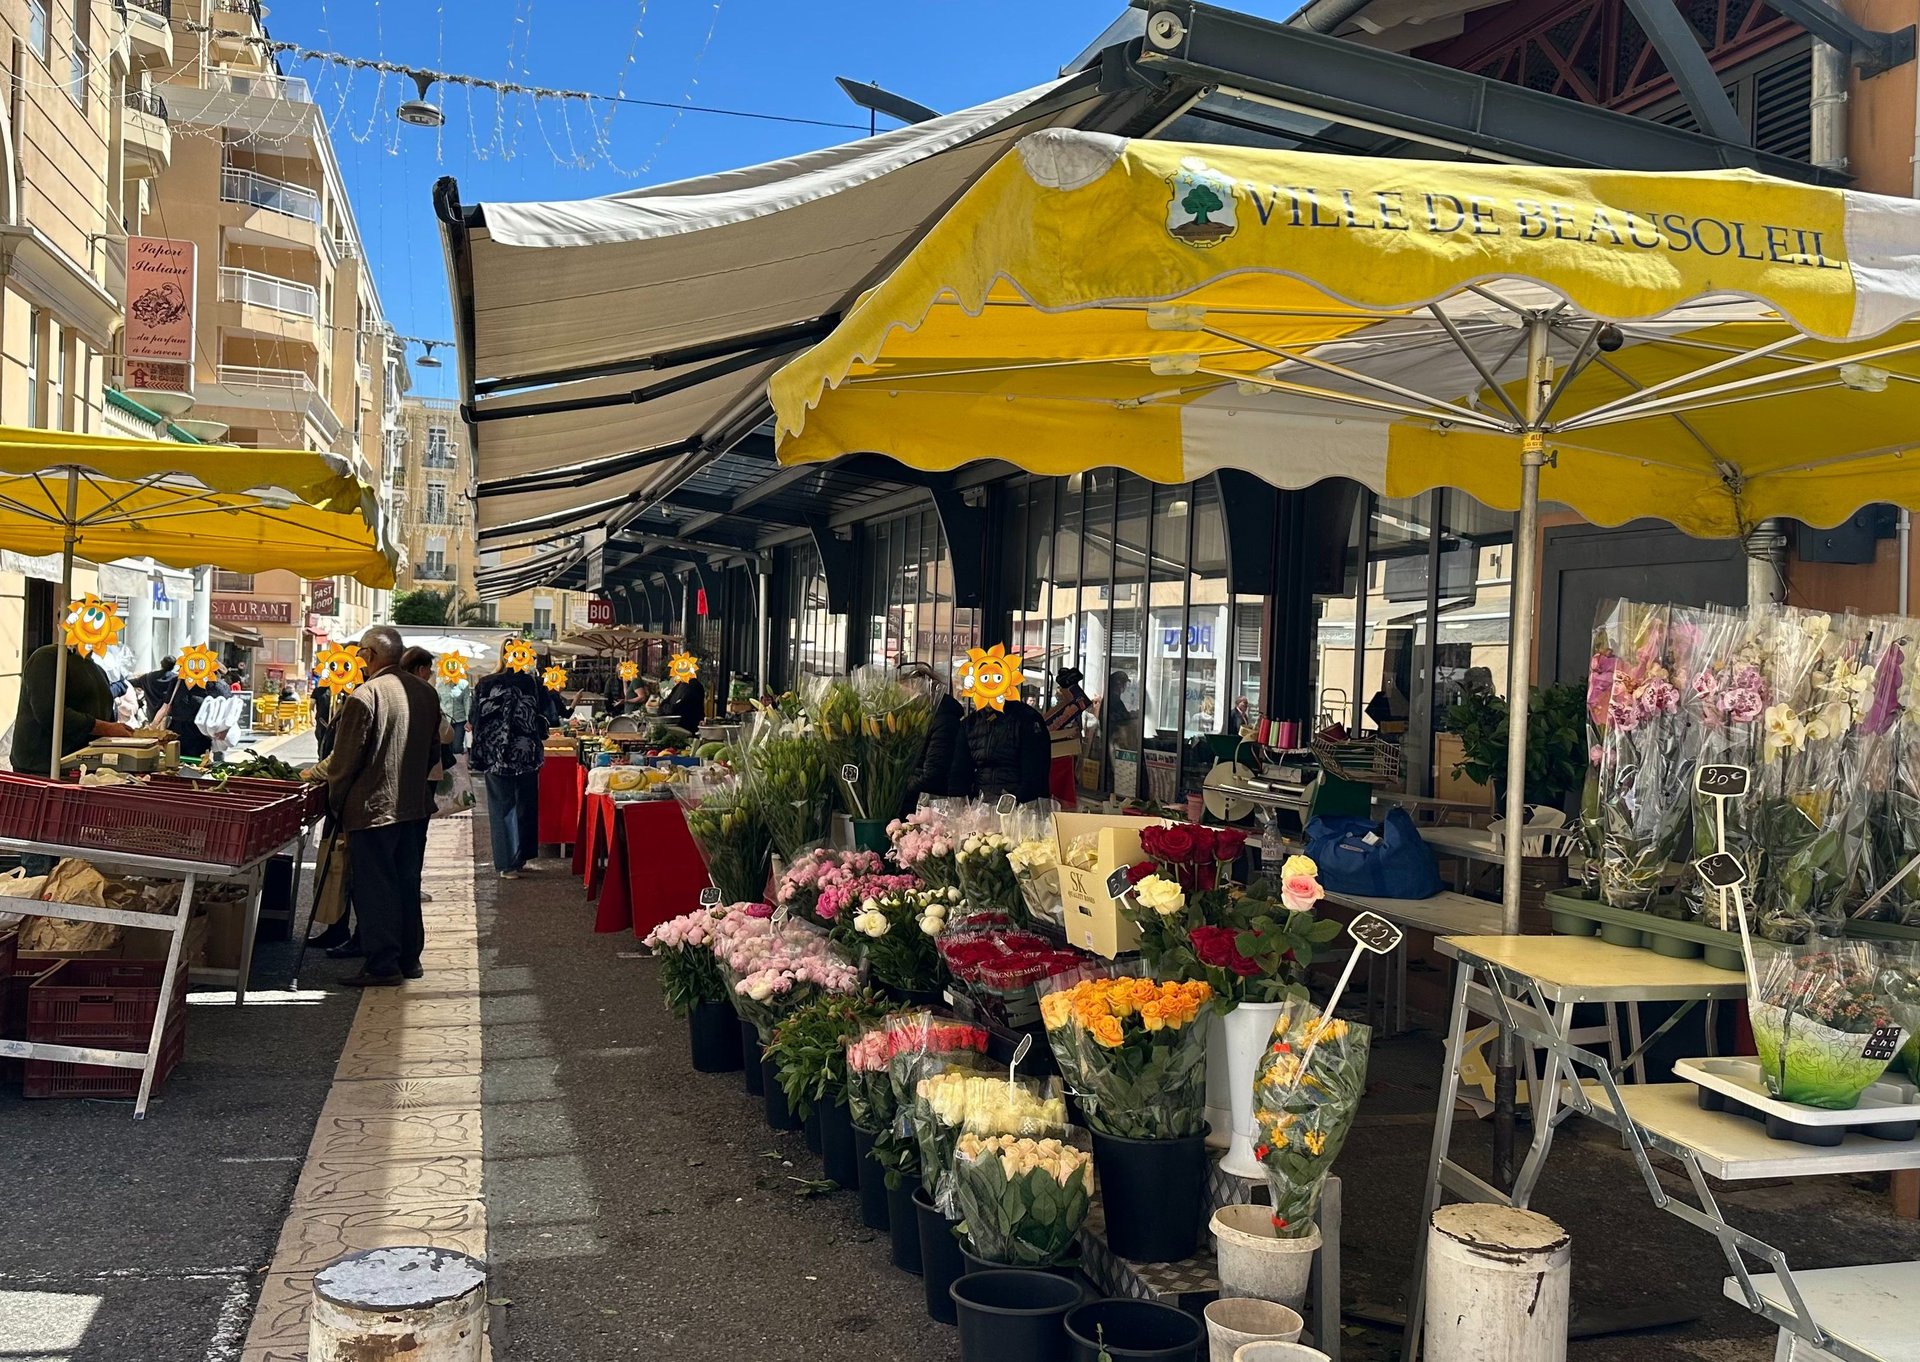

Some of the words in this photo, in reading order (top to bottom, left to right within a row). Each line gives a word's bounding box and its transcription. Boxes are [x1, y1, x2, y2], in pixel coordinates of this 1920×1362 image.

[1245, 184, 1409, 231] VILLE
[1421, 193, 1501, 235] DE
[1515, 199, 1842, 270] BEAUSOLEIL
[138, 242, 183, 258] Sapori
[132, 261, 188, 275] Italiani
[149, 335, 186, 345] parfum
[142, 346, 151, 354] la
[314, 586, 332, 599] FAST
[211, 602, 288, 616] STAURANT
[312, 597, 333, 611] FOOD
[590, 604, 610, 620] BIO
[1702, 768, 1744, 786] 20€
[1070, 871, 1088, 895] SK
[1864, 1049, 1891, 1058] orn
